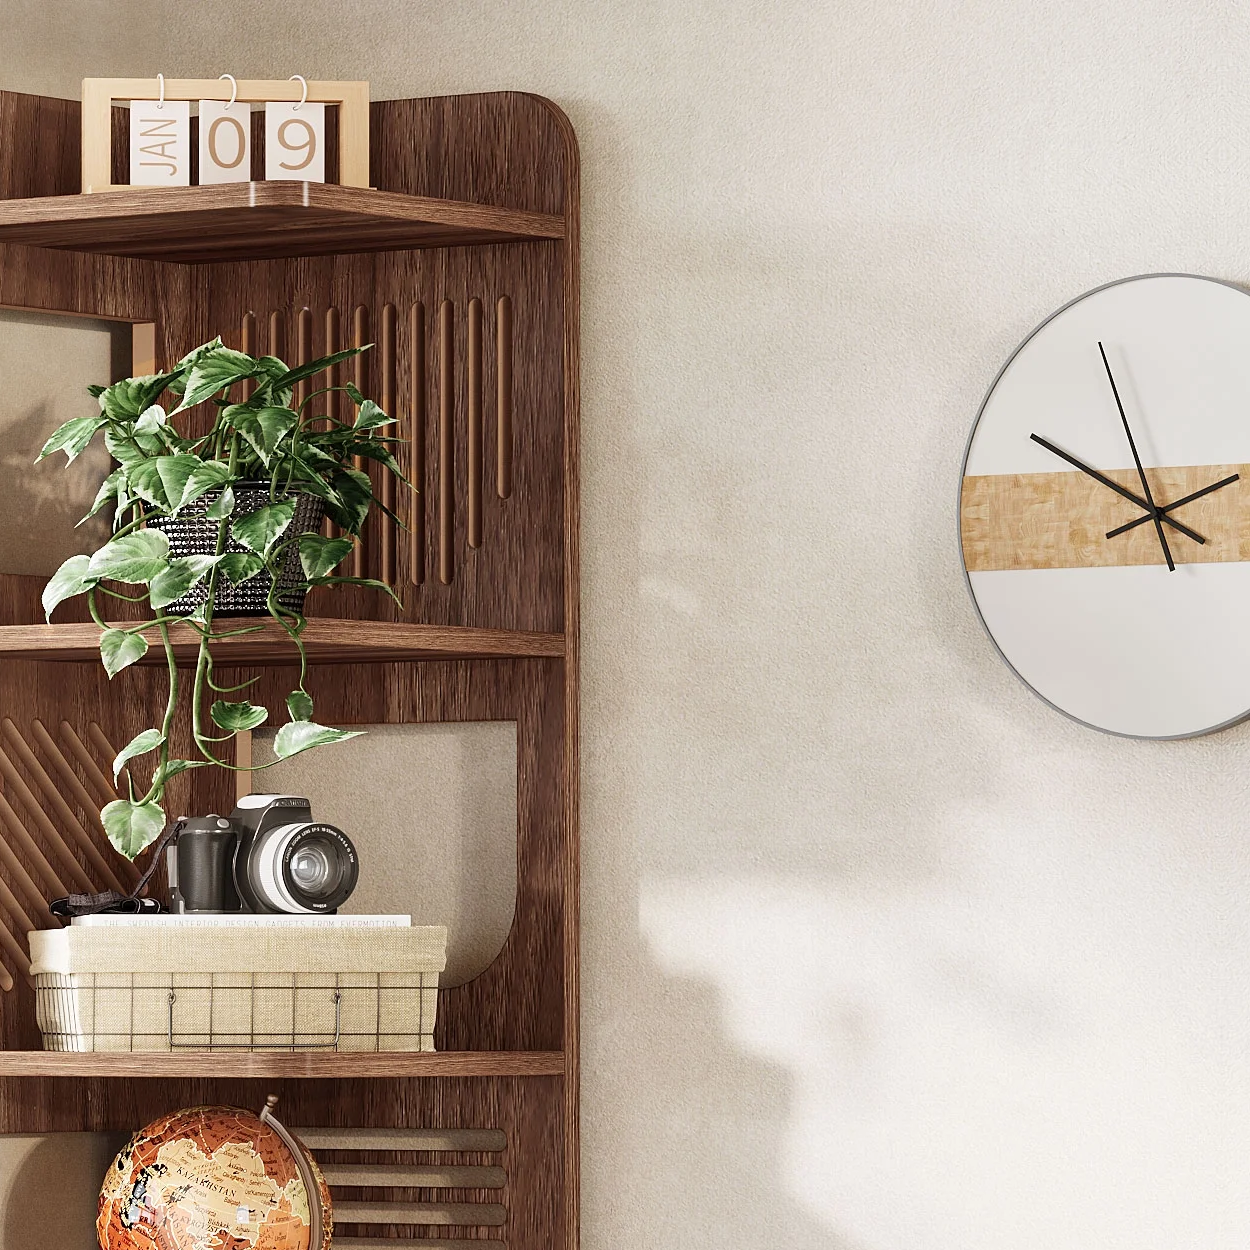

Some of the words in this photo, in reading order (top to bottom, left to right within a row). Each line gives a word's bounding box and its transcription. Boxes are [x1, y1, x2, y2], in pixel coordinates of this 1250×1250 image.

[139, 119, 177, 176] JAN
[208, 116, 246, 169] 0
[277, 118, 317, 171] 9
[176, 1165, 237, 1198] KAZAKHSTAN
